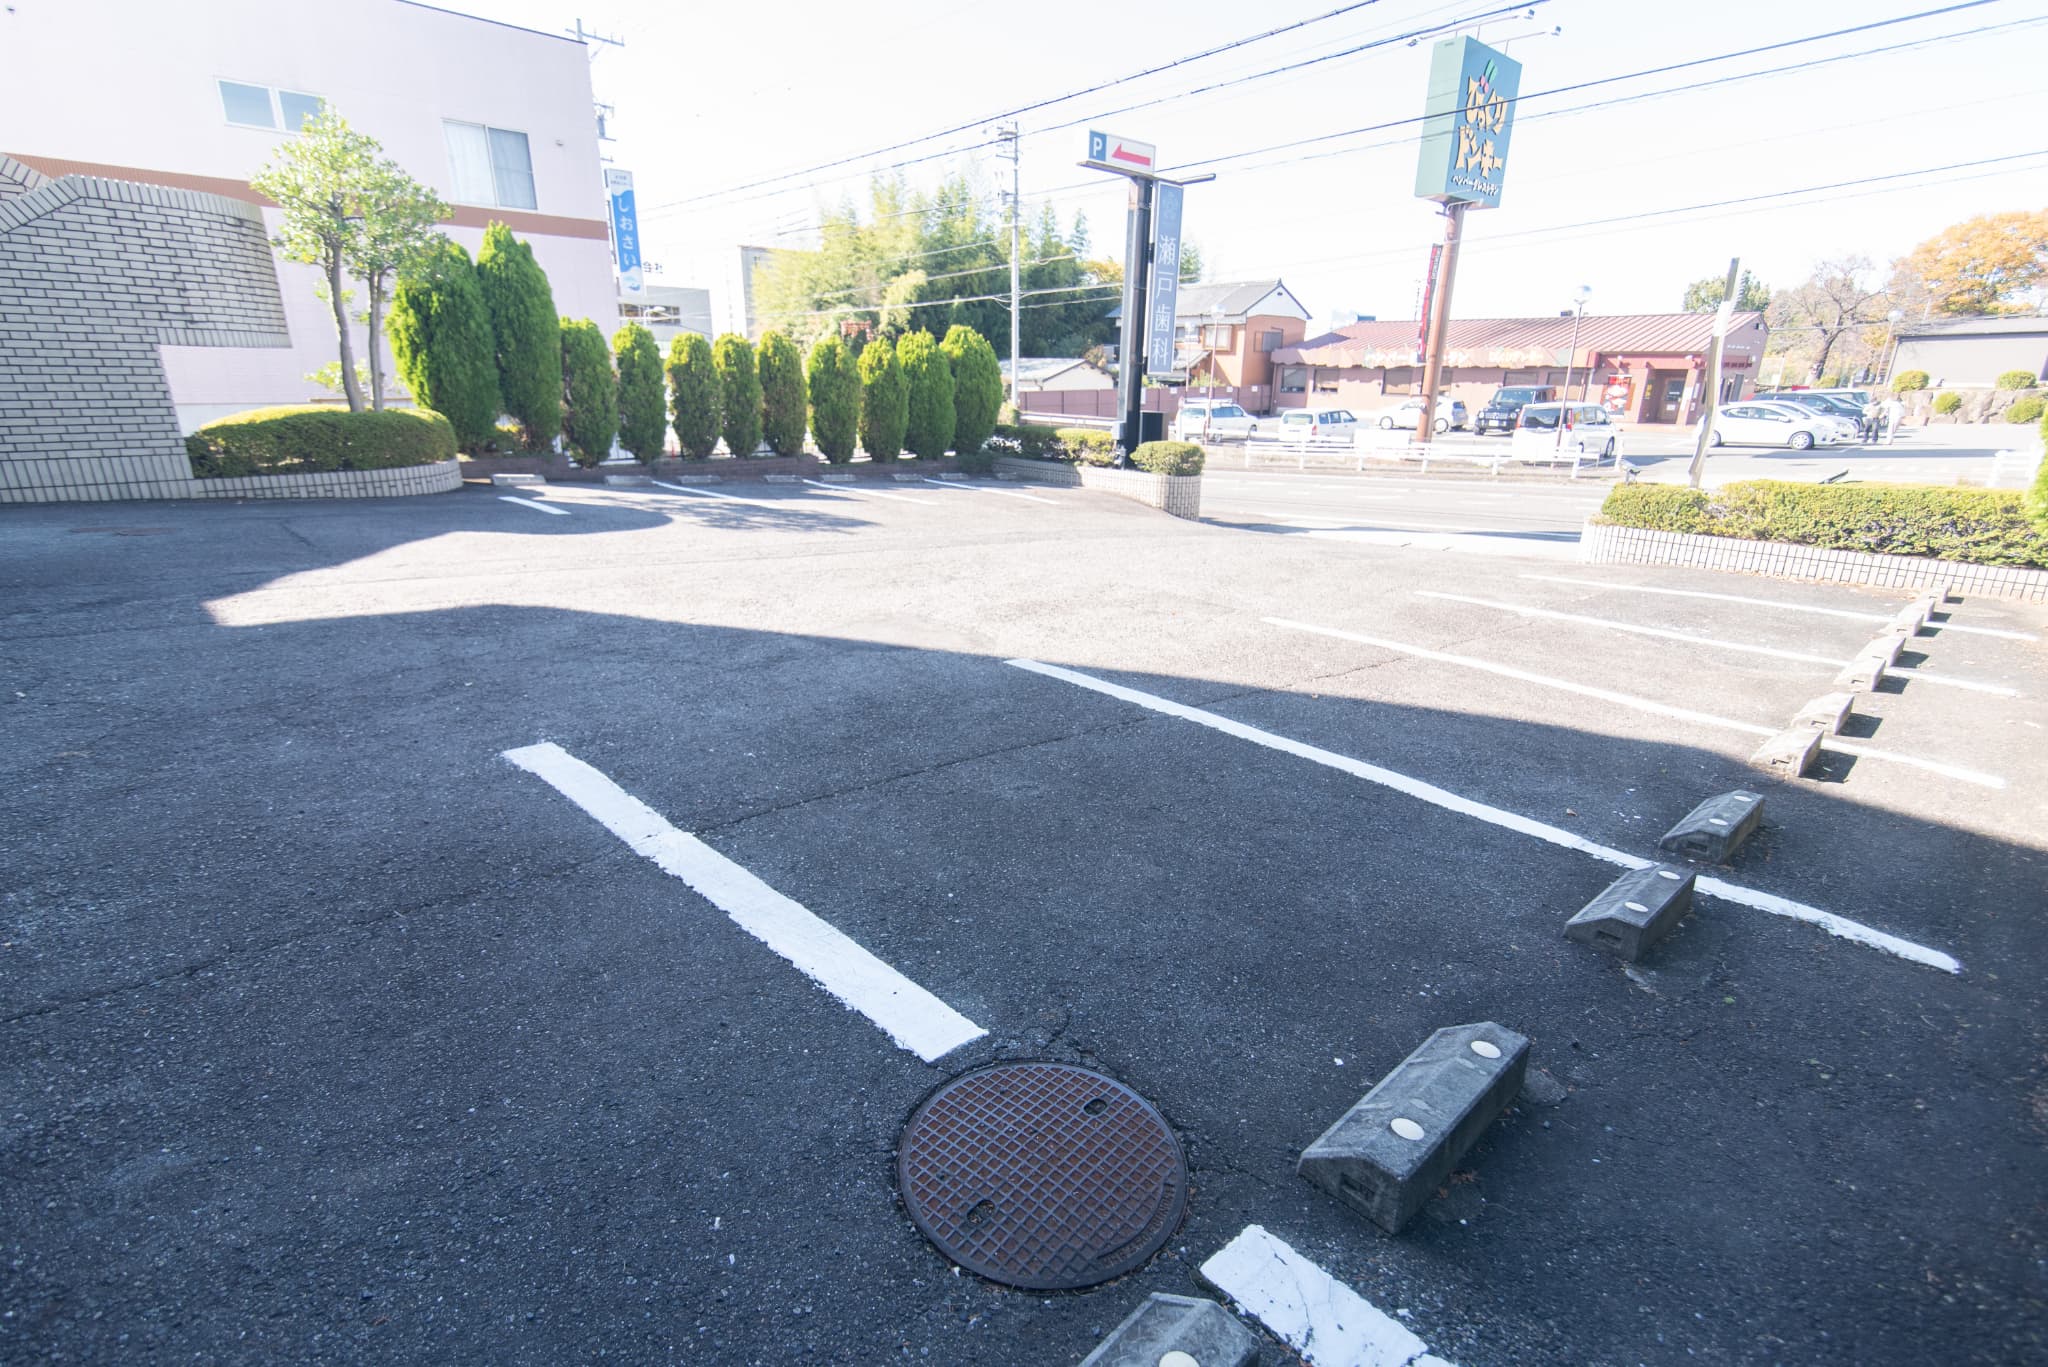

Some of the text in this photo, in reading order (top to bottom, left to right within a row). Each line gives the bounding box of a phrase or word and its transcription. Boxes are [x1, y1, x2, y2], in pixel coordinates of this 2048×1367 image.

[1466, 74, 1508, 136] びっくり
[1093, 136, 1103, 157] P
[1456, 125, 1503, 178] ドンキー
[618, 197, 637, 266] しおさい
[1152, 234, 1177, 367] 瀬戸歯科
